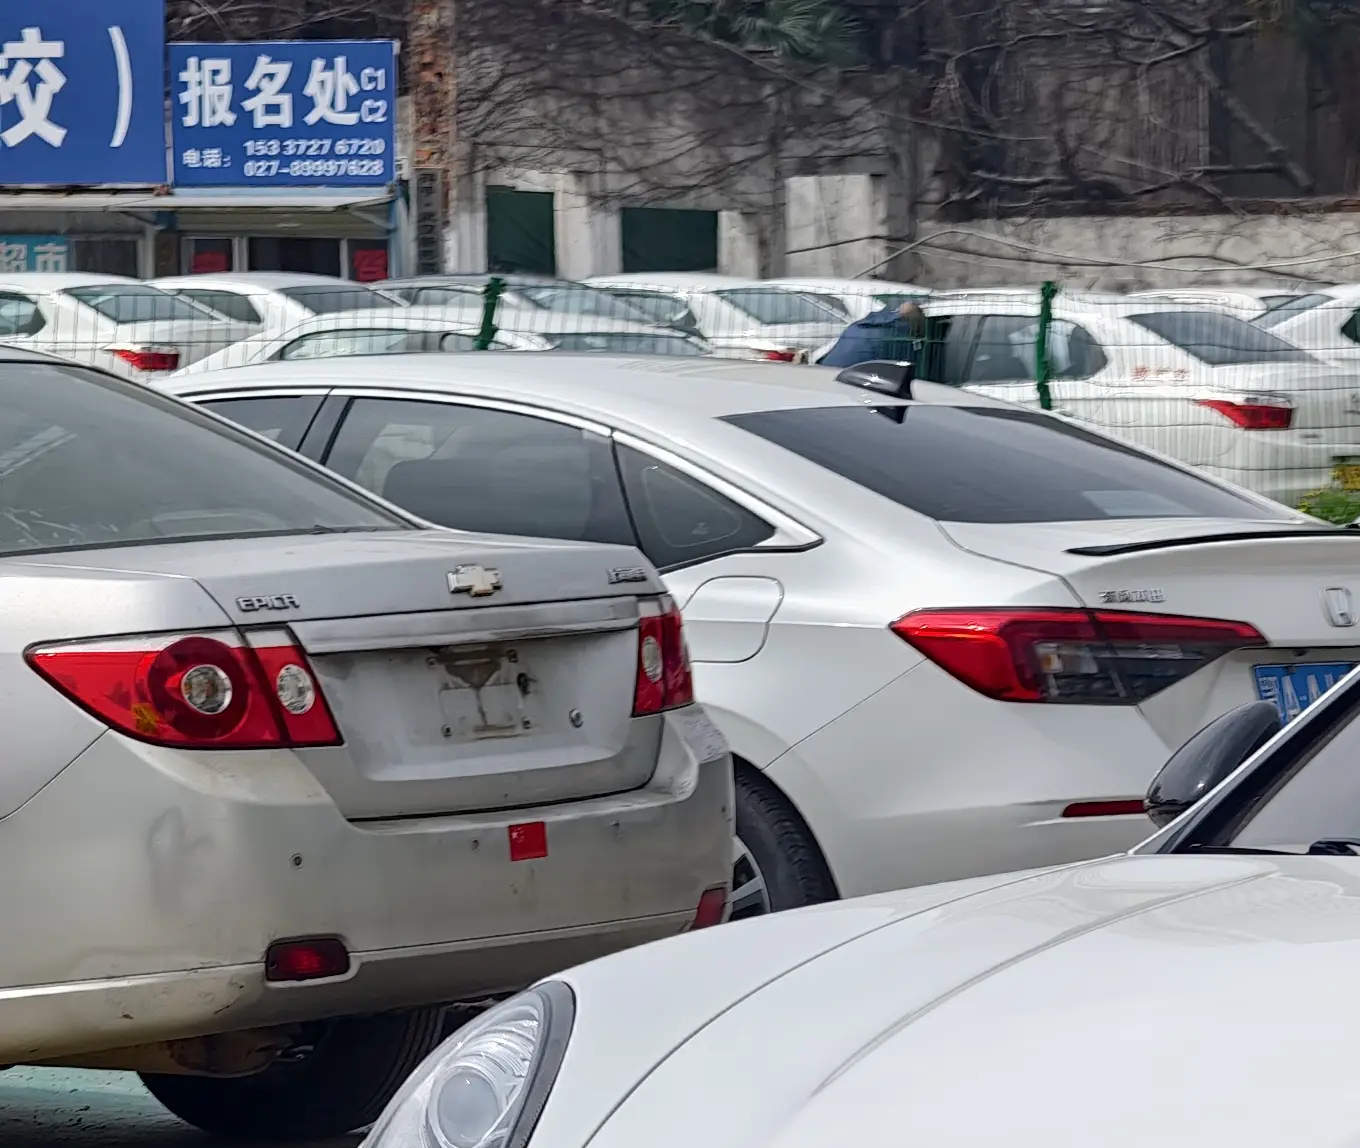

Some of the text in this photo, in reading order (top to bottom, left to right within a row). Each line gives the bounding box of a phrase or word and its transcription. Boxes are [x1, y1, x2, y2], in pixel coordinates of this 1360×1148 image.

[360, 67, 387, 91] C1
[178, 54, 361, 129] 报名处
[360, 98, 388, 123] C2
[243, 138, 281, 156] 153
[236, 593, 301, 612] EPICA
